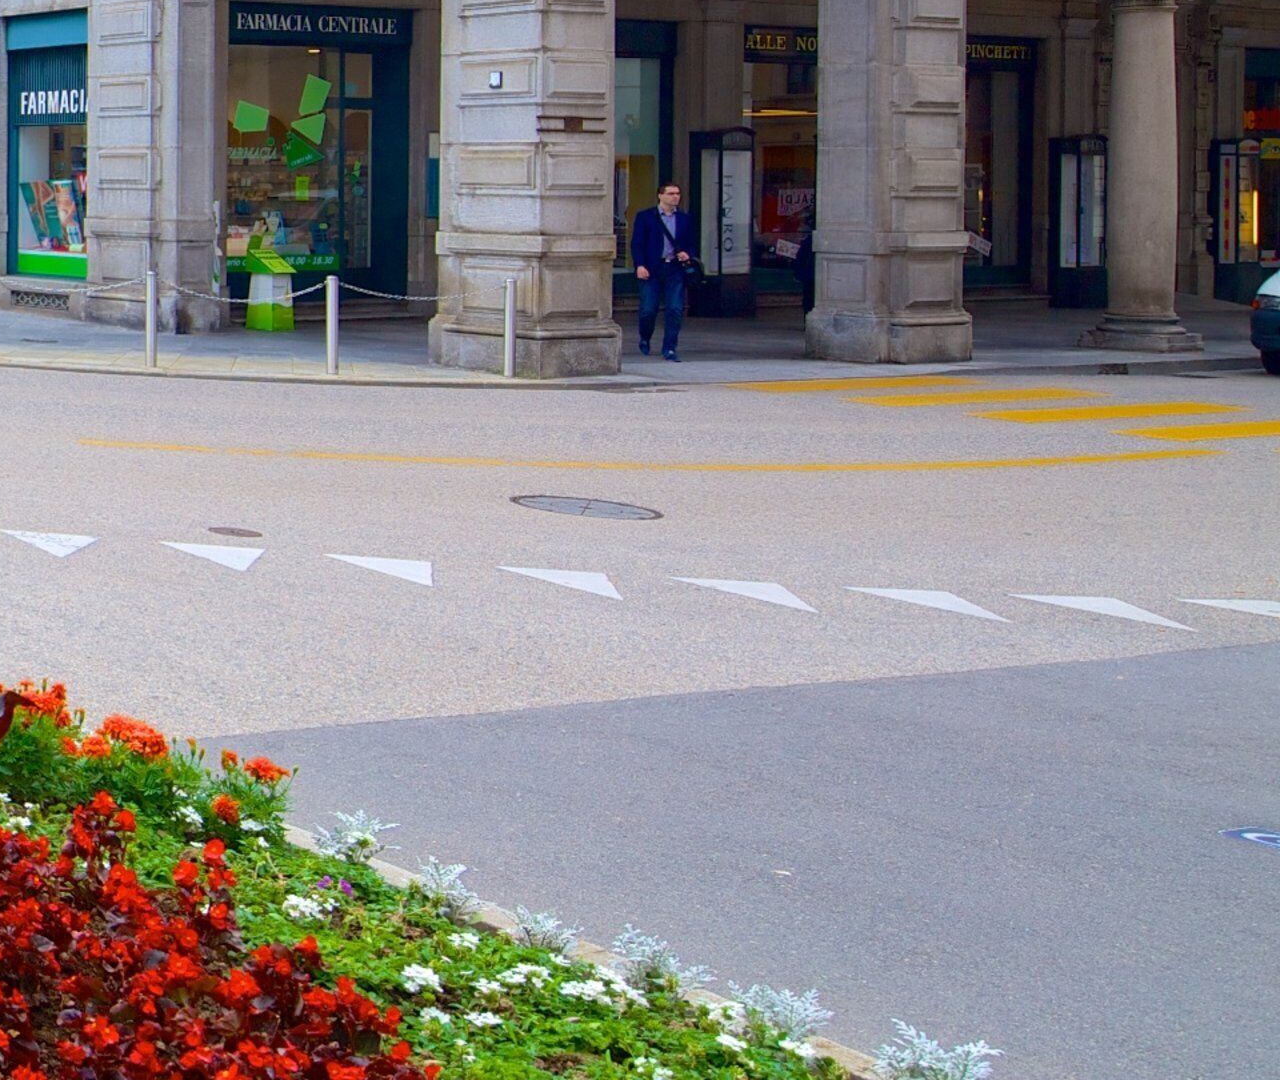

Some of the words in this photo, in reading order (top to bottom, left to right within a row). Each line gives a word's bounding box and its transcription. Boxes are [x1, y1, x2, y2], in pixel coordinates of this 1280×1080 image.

[236, 12, 312, 32] FARMACIA
[318, 16, 397, 35] CENTRALE
[745, 34, 786, 51] ALLE
